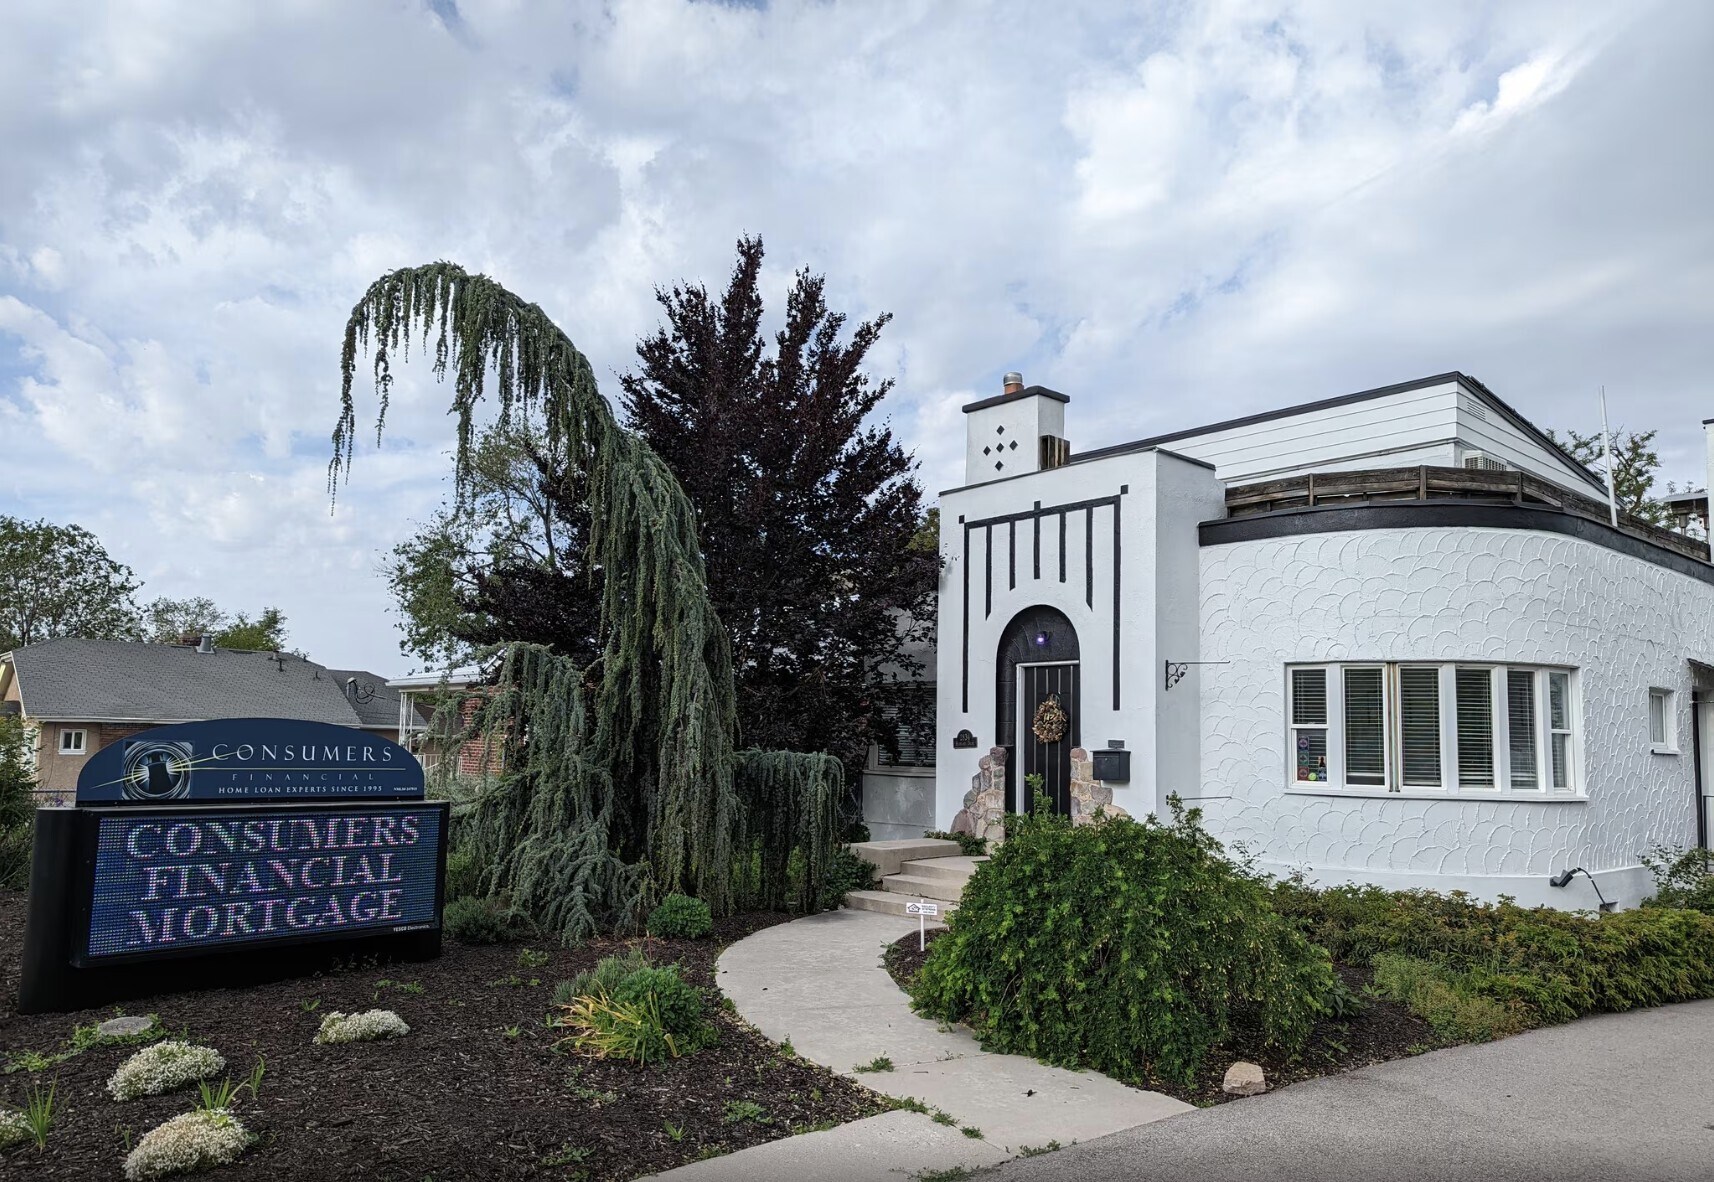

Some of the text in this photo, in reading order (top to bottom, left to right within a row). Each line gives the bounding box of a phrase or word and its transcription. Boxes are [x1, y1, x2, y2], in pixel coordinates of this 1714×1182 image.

[212, 743, 392, 762] CONSUMERS
[218, 786, 249, 794] HOME
[286, 785, 327, 793] EXPERTS
[232, 773, 374, 781] FINANCIAL
[126, 815, 420, 858] CONSUMERS
[141, 853, 403, 901] FINANCIAL
[127, 888, 403, 945] MORTGAGE
